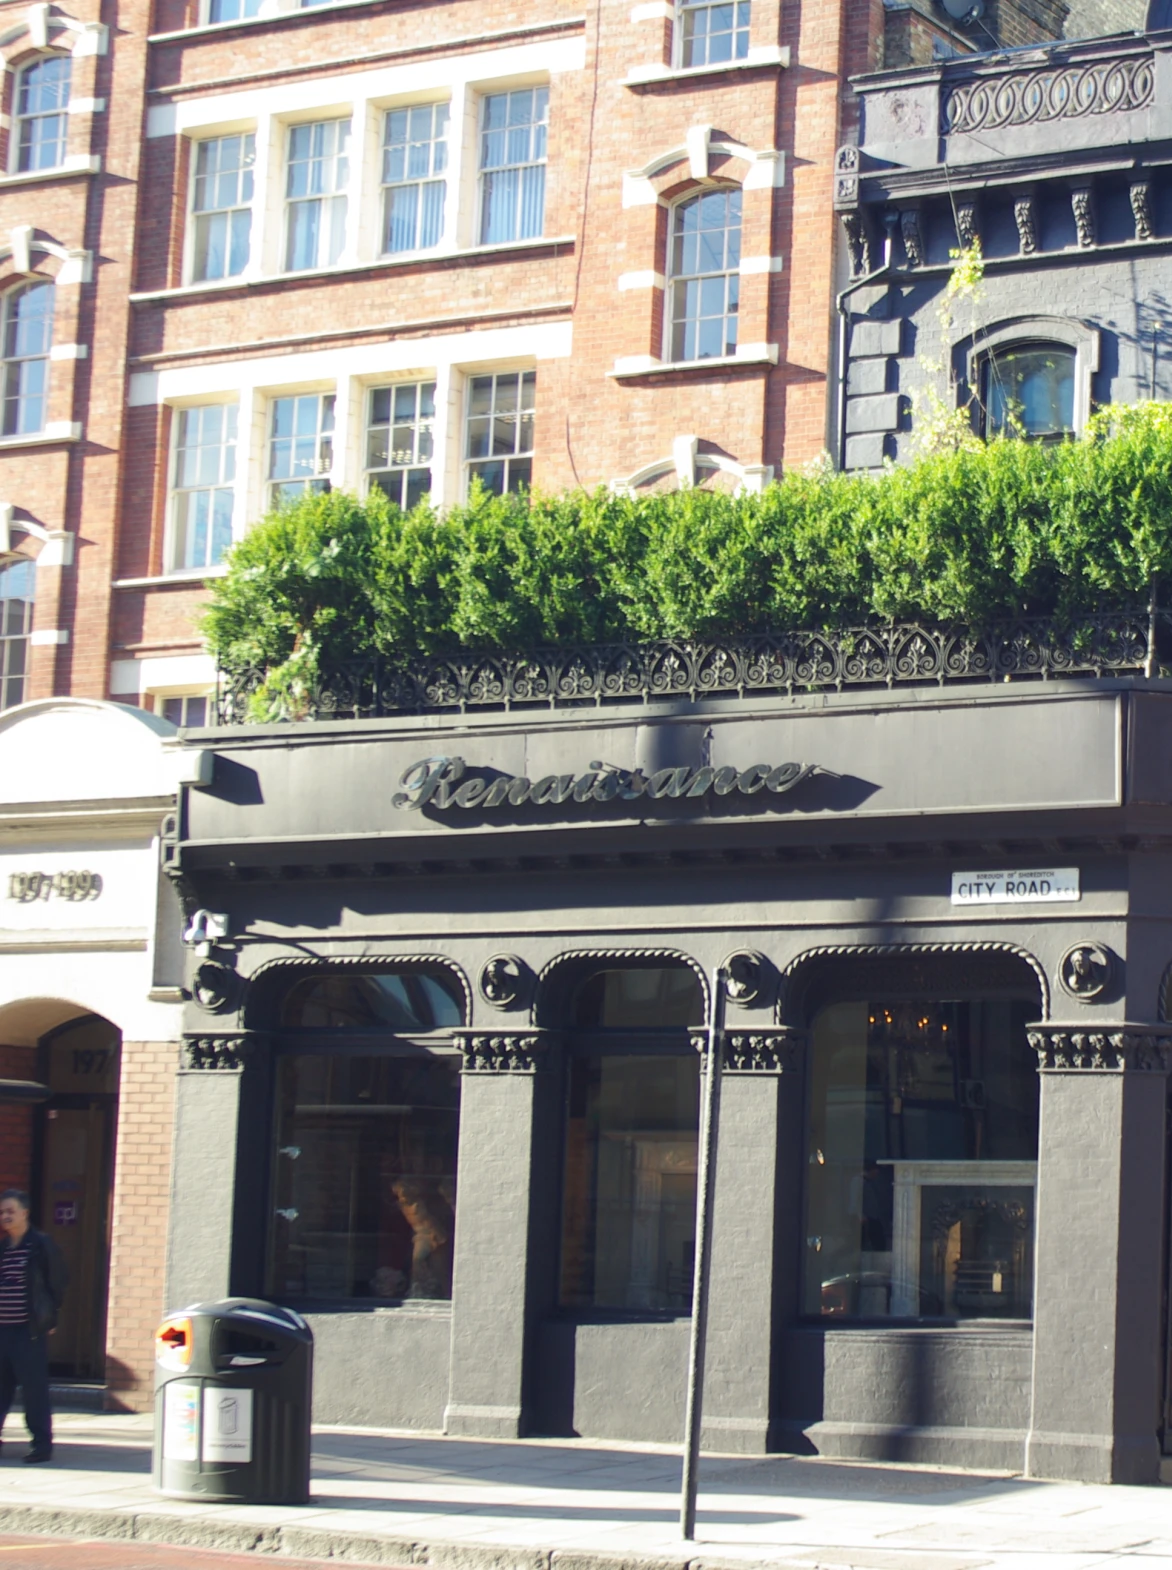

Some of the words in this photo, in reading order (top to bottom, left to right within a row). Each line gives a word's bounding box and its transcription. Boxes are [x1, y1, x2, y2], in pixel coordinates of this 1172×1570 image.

[393, 755, 824, 810] Renaissance
[7, 870, 101, 902] 197-199
[1018, 871, 1055, 879] SHOREDITCH
[958, 882, 996, 899] CITY
[1005, 880, 1051, 897] ROAD
[73, 1049, 109, 1074] 197
